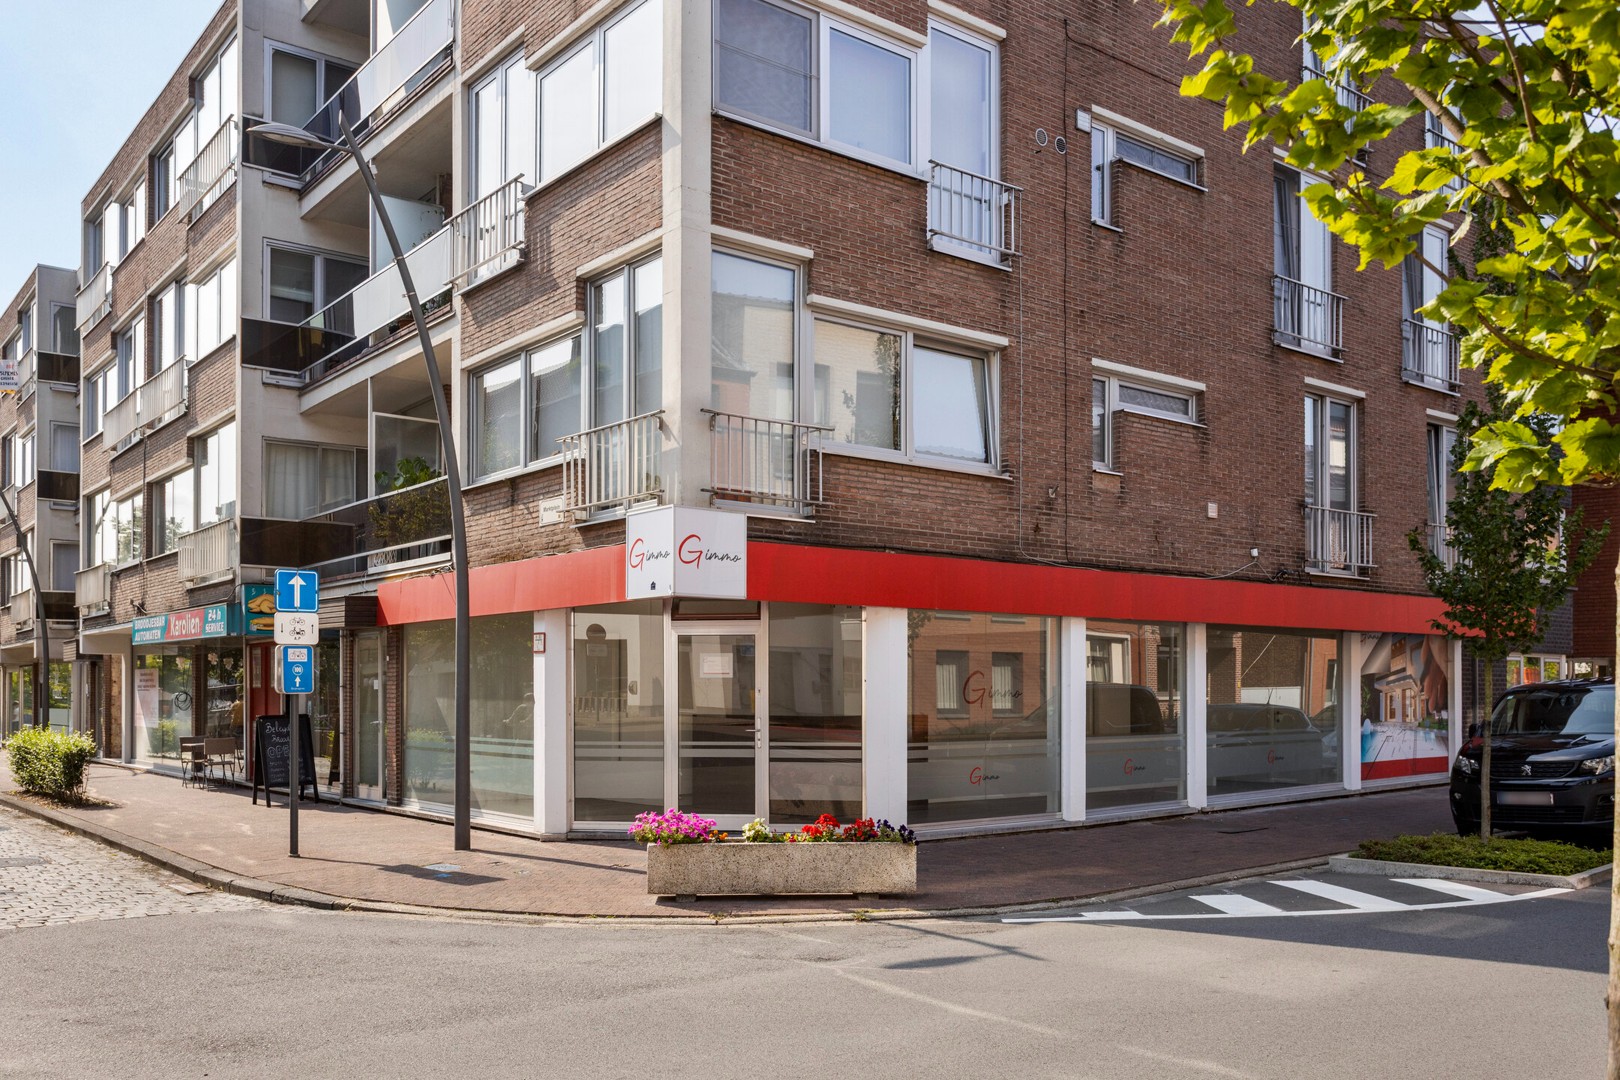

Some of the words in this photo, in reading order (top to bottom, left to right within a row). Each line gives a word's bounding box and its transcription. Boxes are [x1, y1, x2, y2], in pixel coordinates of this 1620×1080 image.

[630, 538, 670, 571] Gimmo
[678, 534, 741, 569] Gimmo
[208, 609, 216, 621] 24
[170, 613, 200, 637] Karolien
[205, 621, 224, 633] SERVICE
[135, 630, 161, 641] AUTOMATEN
[963, 670, 1023, 709] Gimmo
[268, 745, 290, 758] OPE
[969, 767, 1000, 786] Gimmo
